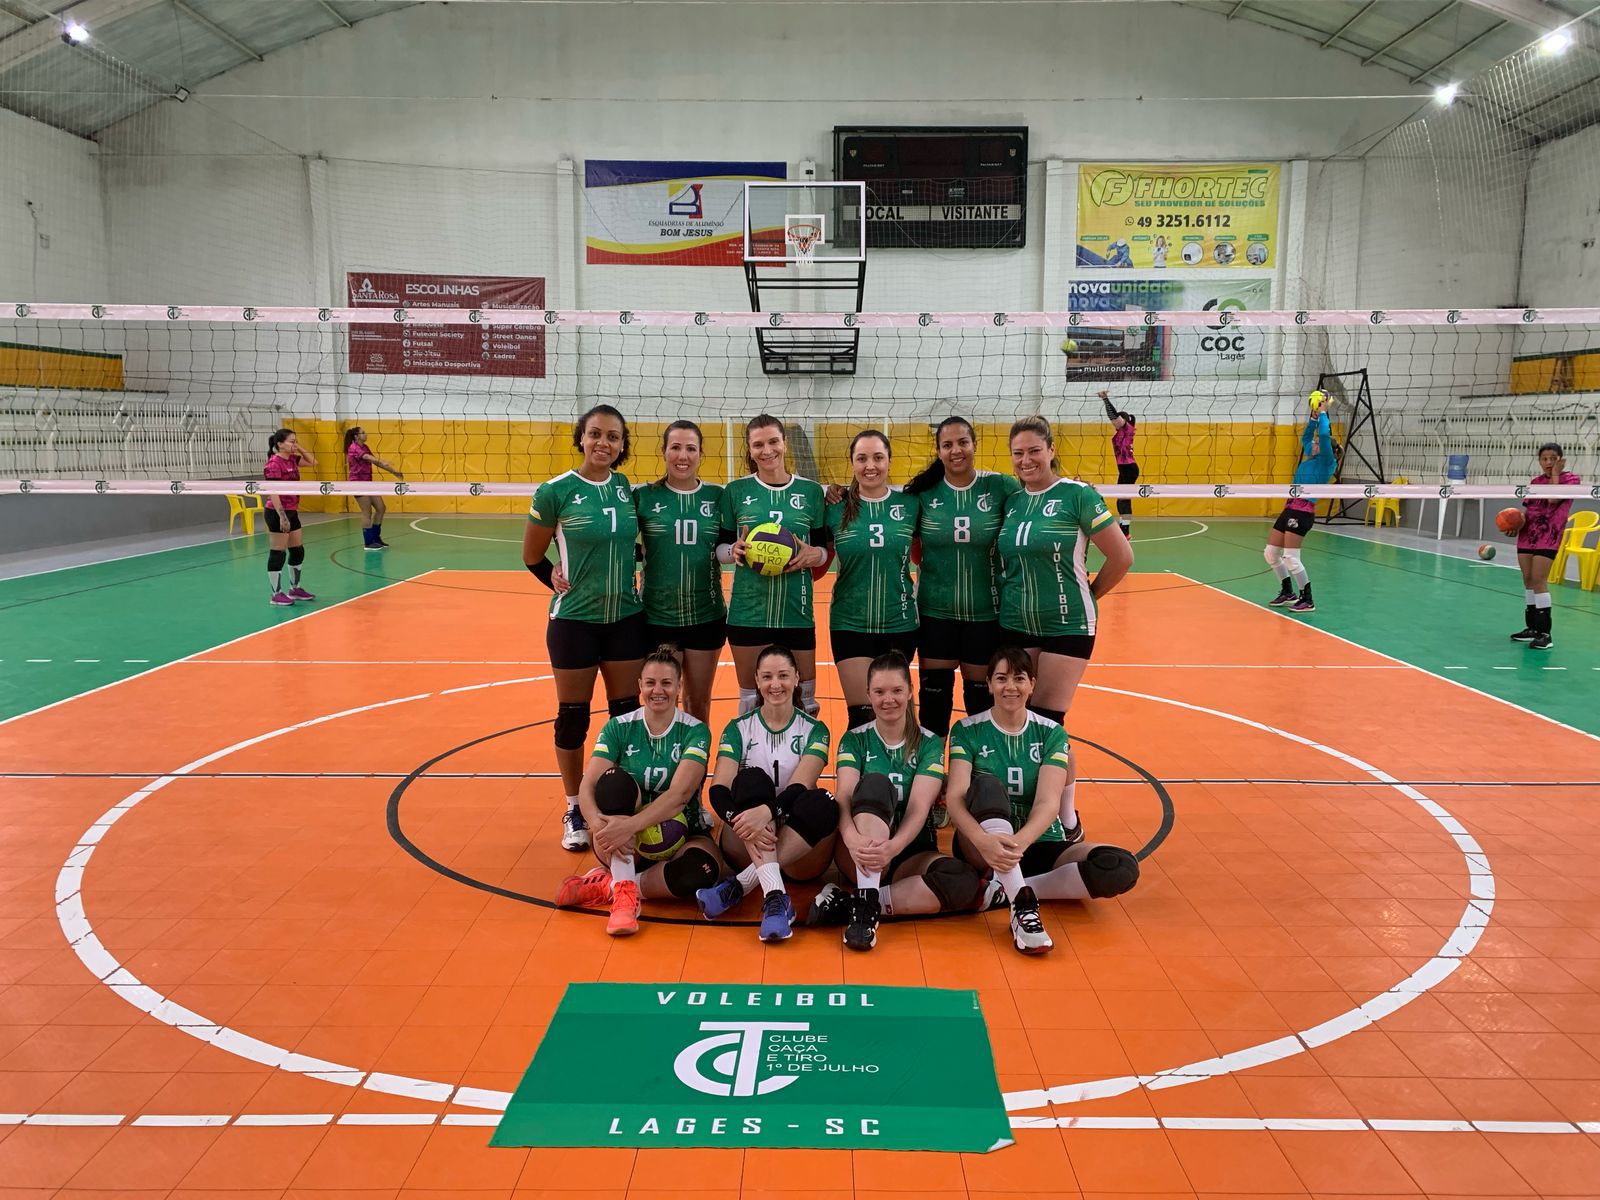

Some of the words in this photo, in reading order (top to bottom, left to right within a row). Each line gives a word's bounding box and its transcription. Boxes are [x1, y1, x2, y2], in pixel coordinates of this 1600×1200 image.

[1134, 176, 1269, 199] FHORTEC
[941, 206, 1009, 220] VISITANTE
[1137, 216, 1153, 228] 49
[1156, 214, 1231, 228] 3251.6112
[660, 228, 681, 237] BOM
[682, 228, 713, 237] JESUS
[405, 283, 480, 297] ESCOLINHAS
[1220, 352, 1246, 362] Lages
[1083, 365, 1156, 373] multiconectados
[602, 507, 617, 533] 7
[673, 518, 698, 545] 10
[869, 523, 885, 548] 3
[953, 516, 971, 543] 8
[1015, 520, 1033, 547] 11
[756, 542, 780, 556] CAÇA
[757, 554, 782, 566] TIRO
[1053, 541, 1068, 625] VOLEIBOL
[643, 766, 668, 793] 12
[772, 759, 779, 788] 1
[1007, 766, 1024, 796] 9
[656, 990, 875, 1008] VOLEIBOL
[769, 1034, 828, 1043] CLUBE
[768, 1044, 818, 1054] CAÇA
[766, 1054, 778, 1062] E
[786, 1053, 827, 1062] TIRO
[788, 1063, 813, 1072] DE
[818, 1063, 880, 1073] JULHO
[607, 1116, 763, 1136] LAGES
[825, 1117, 880, 1136] SC
